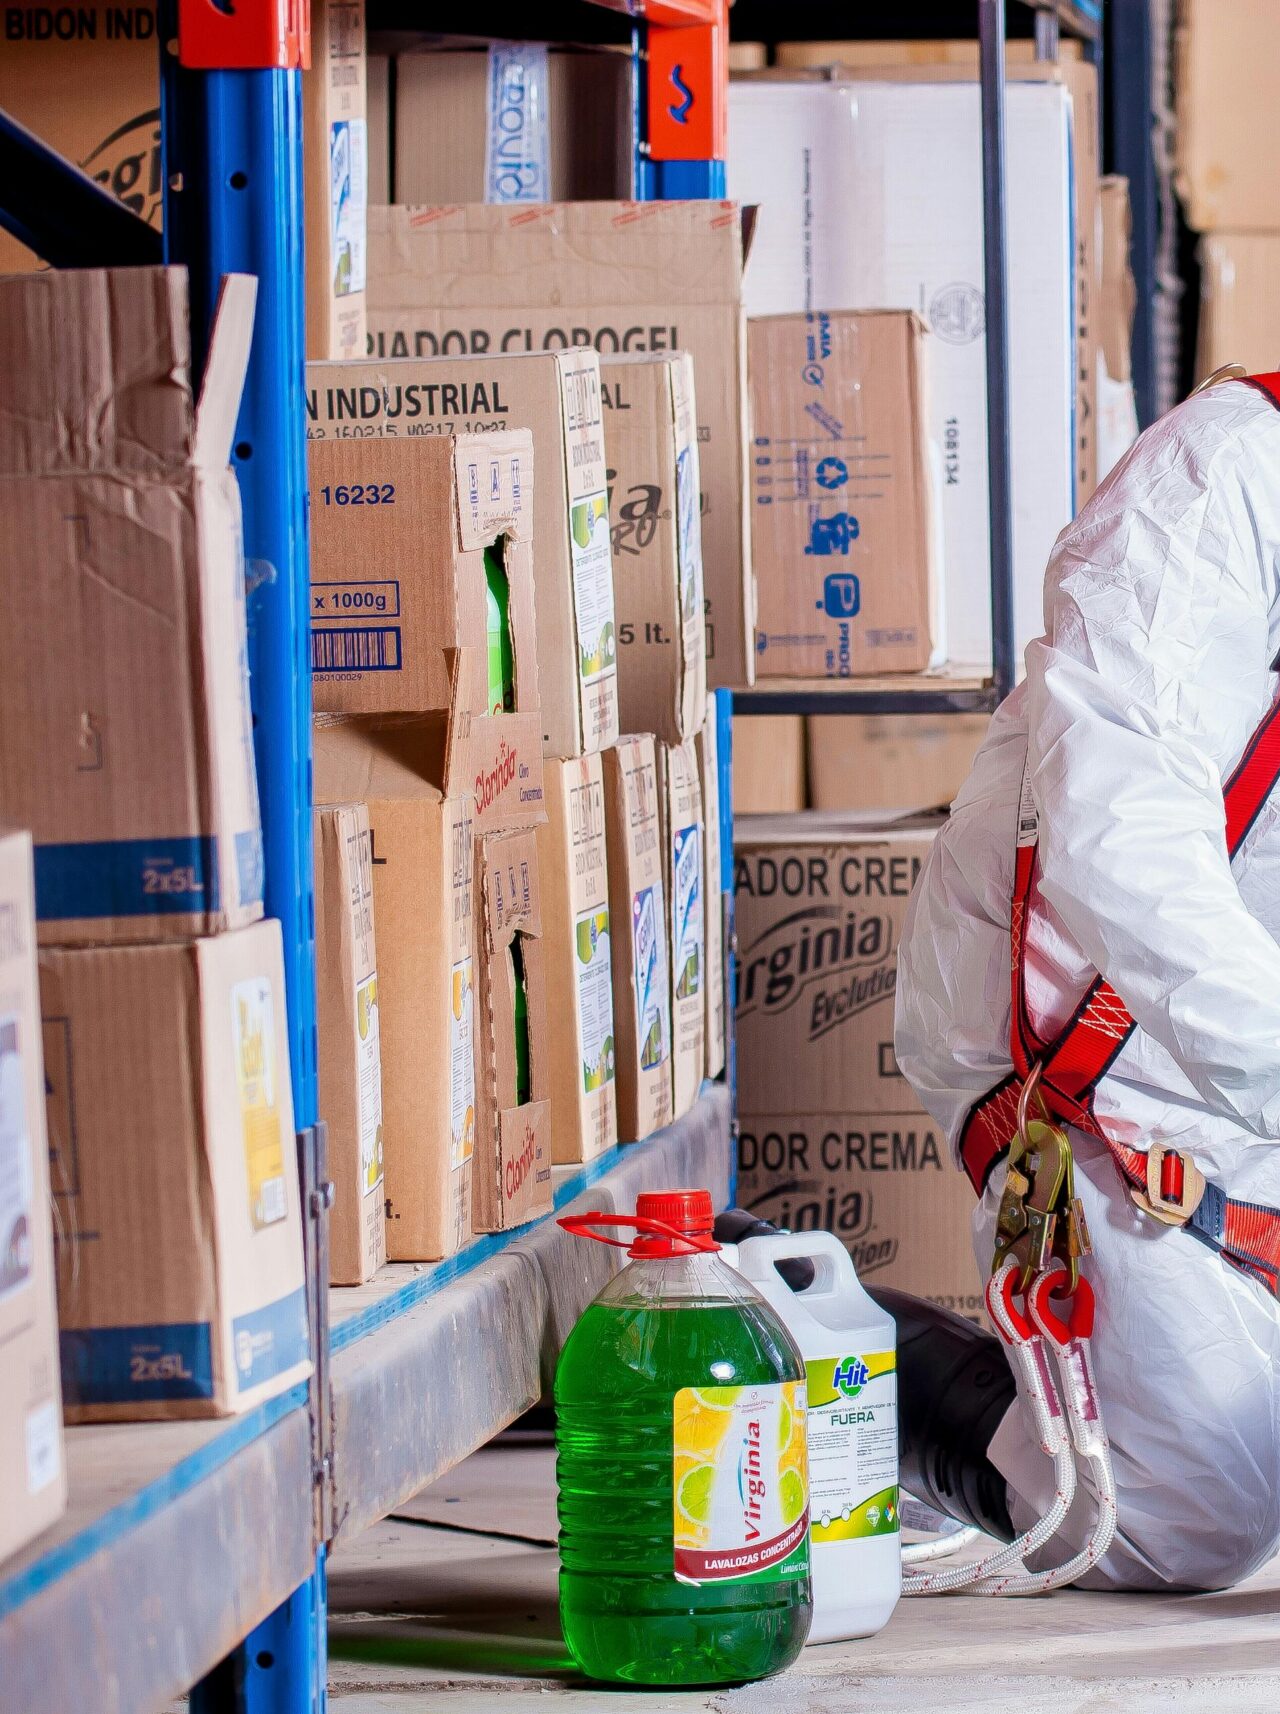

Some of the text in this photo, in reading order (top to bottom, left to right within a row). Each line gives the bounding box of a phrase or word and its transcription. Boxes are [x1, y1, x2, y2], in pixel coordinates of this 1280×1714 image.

[6, 8, 98, 41] BIDON
[327, 381, 509, 420] INDUSTRIAL
[320, 484, 396, 506] 16232
[314, 592, 387, 611] x 1000g
[619, 623, 671, 645] 5 lt.
[474, 744, 517, 816] Clorinda
[820, 1131, 943, 1172] CREMA
[833, 1361, 868, 1388] Hit
[831, 1410, 875, 1426] FUERA
[744, 1418, 767, 1542] Virginia
[704, 1552, 759, 1569] LAVALOZAS
